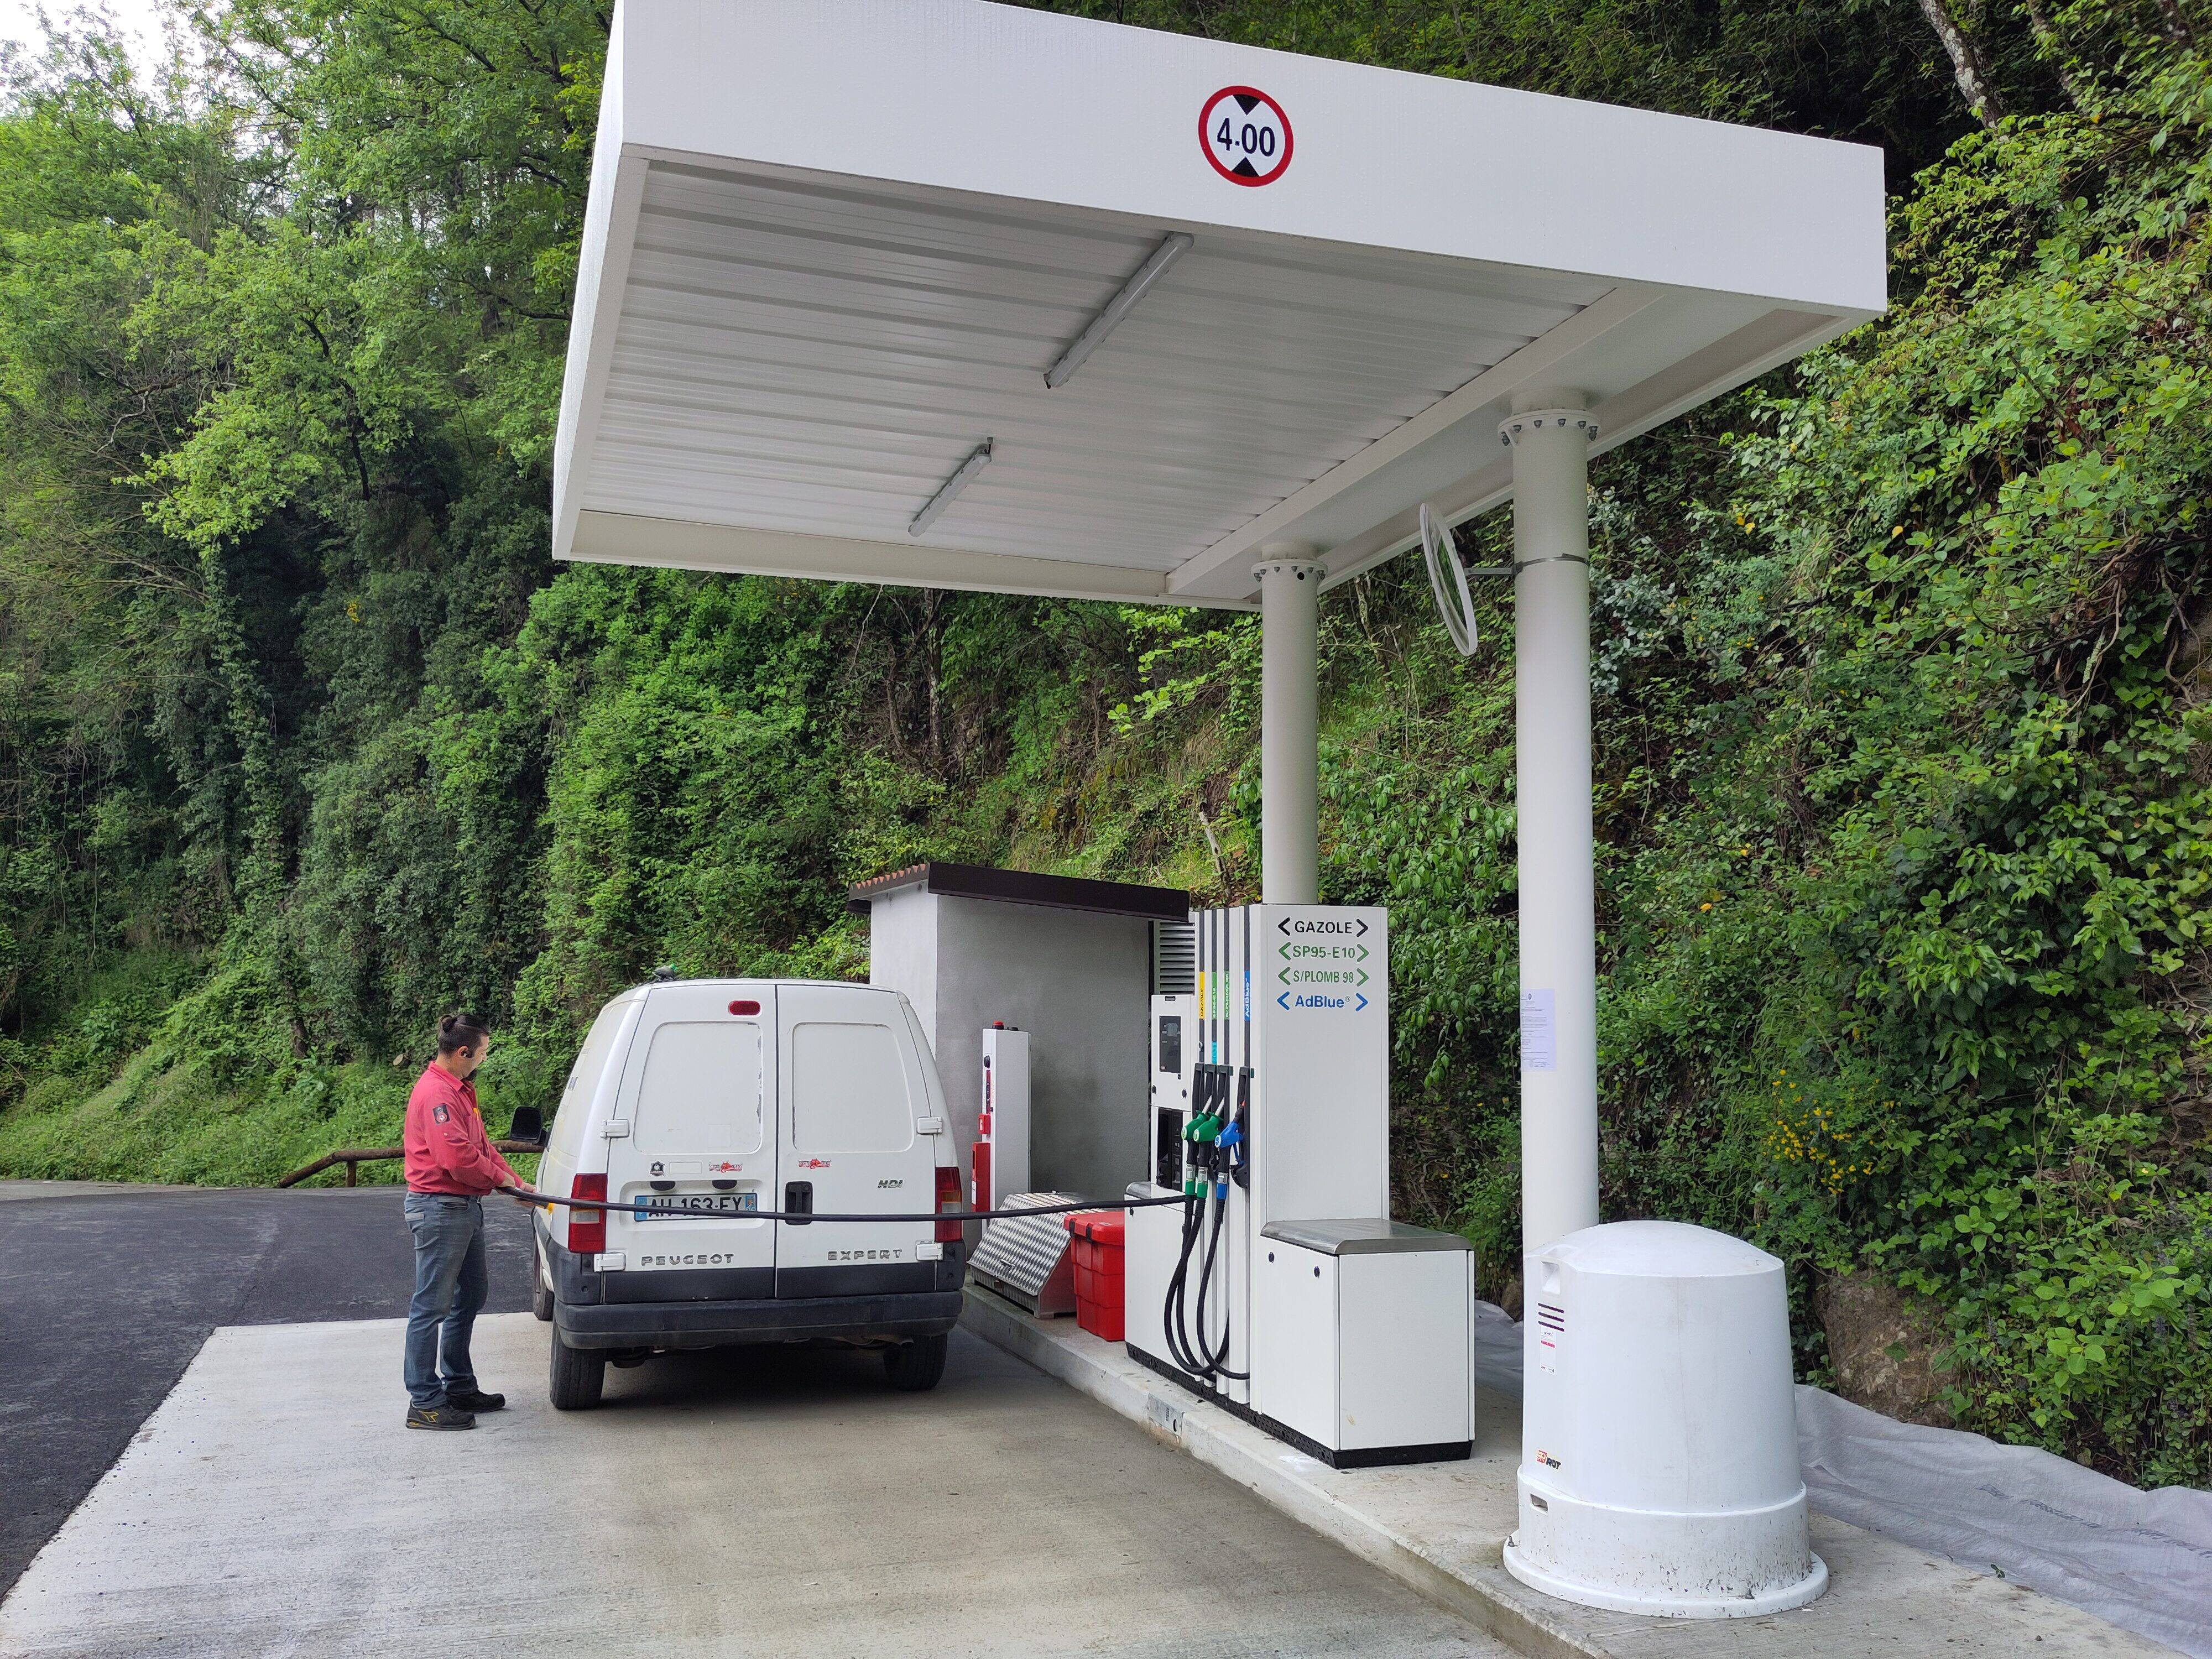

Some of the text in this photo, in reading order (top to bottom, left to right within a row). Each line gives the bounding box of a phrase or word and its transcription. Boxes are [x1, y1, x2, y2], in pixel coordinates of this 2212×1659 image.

[1217, 117, 1275, 157] 4.00
[1295, 921, 1353, 934] GAZOLE
[1292, 945, 1355, 958] SP95-E10
[1293, 970, 1354, 983] S/PLOMB 98
[641, 1254, 734, 1266] PEUGEOT
[827, 1249, 902, 1261] EXPERT
